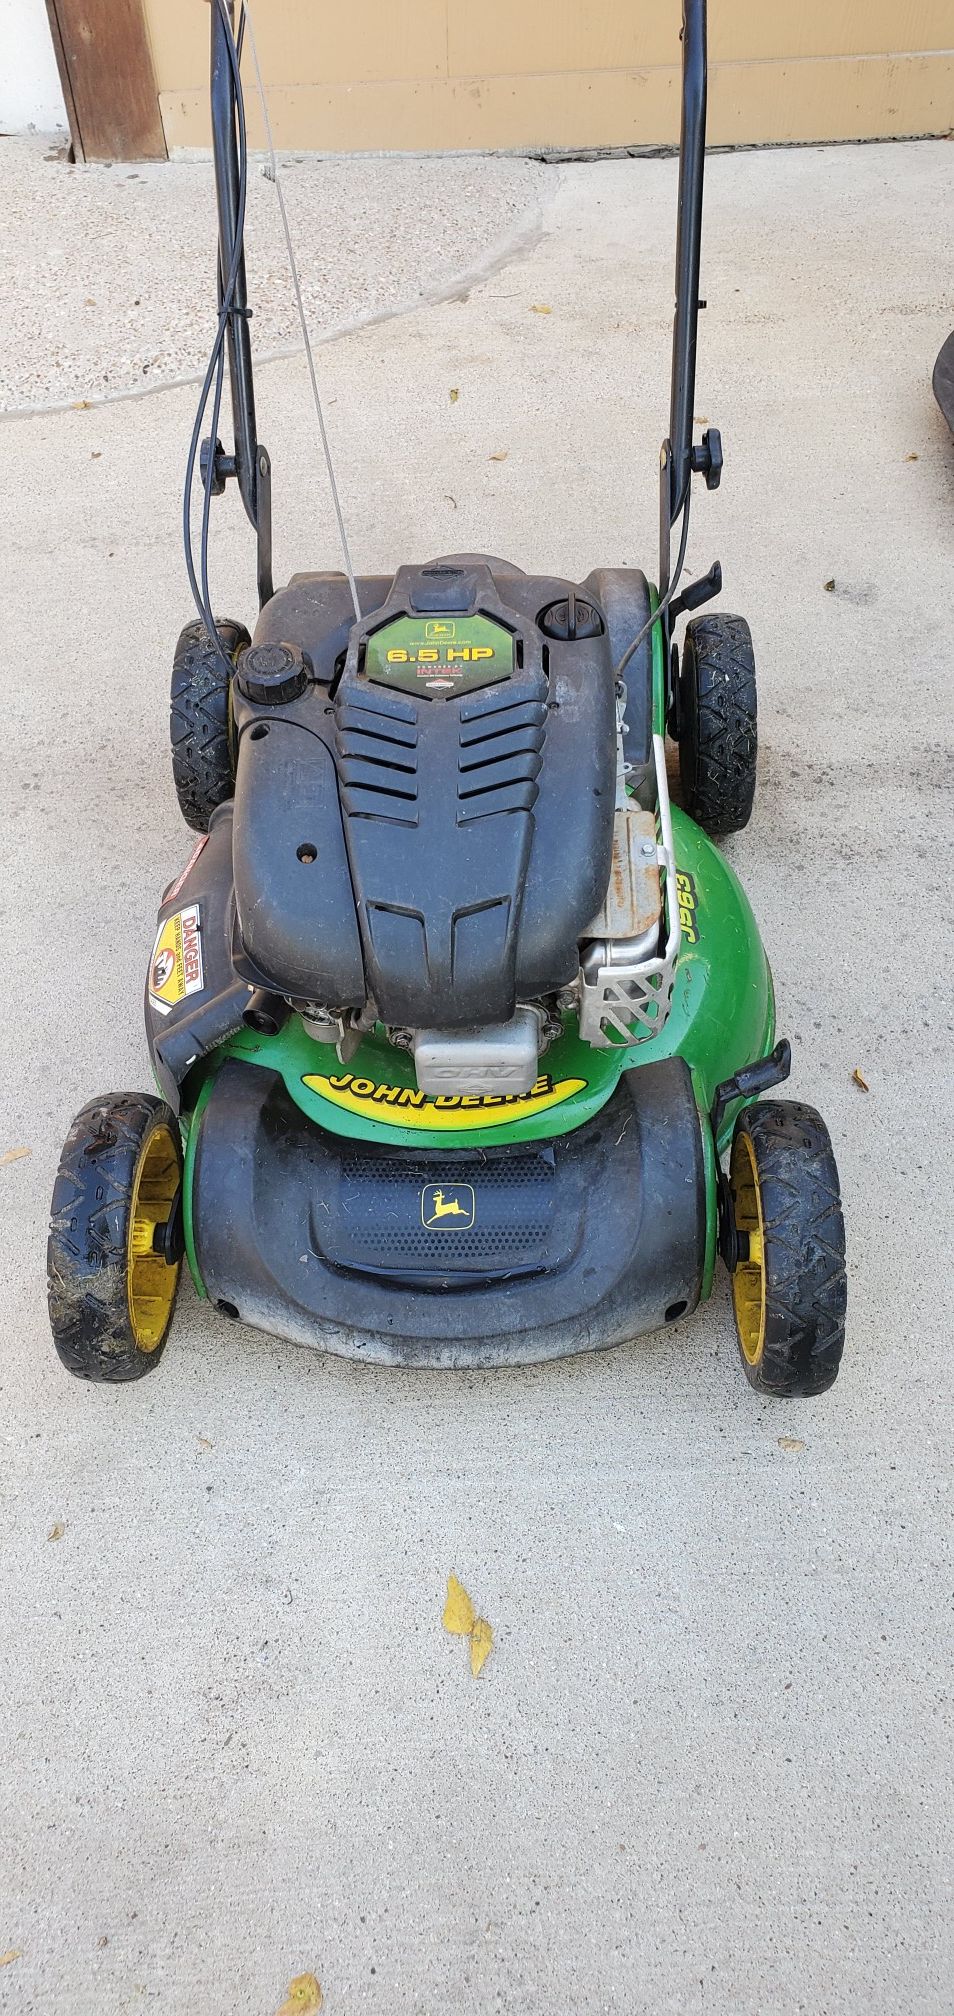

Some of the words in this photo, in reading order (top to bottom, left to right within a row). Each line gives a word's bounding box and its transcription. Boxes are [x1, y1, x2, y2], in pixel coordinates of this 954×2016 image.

[386, 648, 439, 662] 6.5
[446, 647, 495, 661] HP
[676, 871, 698, 944] JS63
[174, 932, 182, 951] HANDS
[182, 915, 199, 985] DANGER
[177, 978, 185, 996] AWAY
[328, 1073, 426, 1108] JOHN
